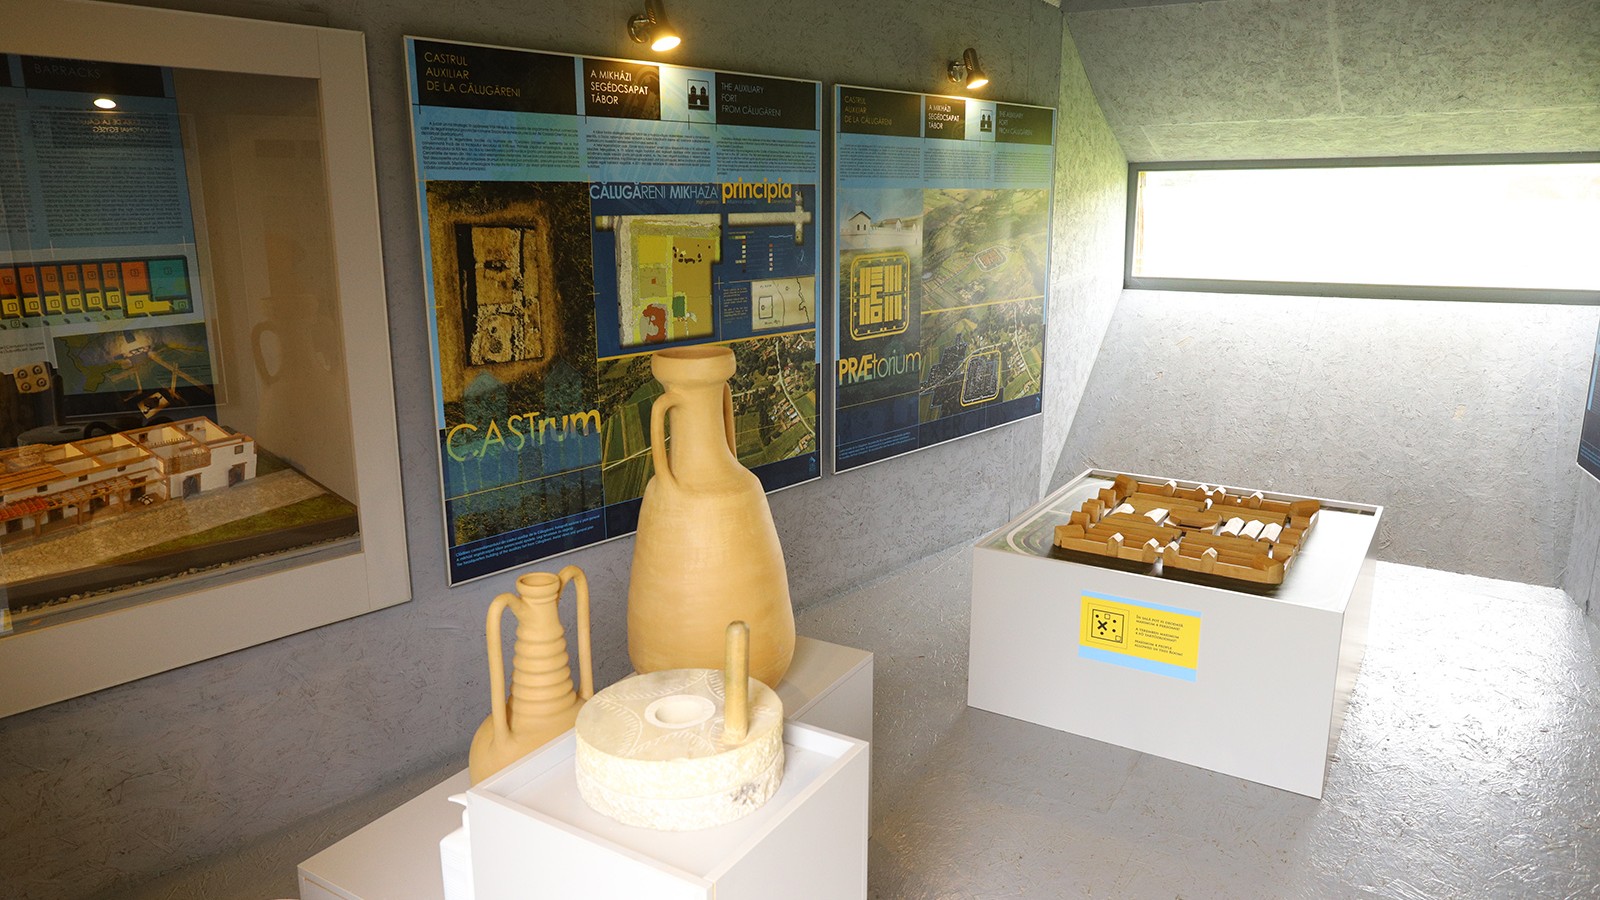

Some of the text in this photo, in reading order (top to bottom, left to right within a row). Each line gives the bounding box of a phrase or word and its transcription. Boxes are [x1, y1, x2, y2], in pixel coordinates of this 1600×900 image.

[424, 52, 468, 66] CASTRUL
[34, 63, 100, 79] BARRACKS
[426, 68, 470, 80] AUXILIAR
[590, 70, 632, 81] A MIKHÁZI
[426, 81, 521, 97] DE LA CĂLUGĂRENI
[590, 80, 648, 95] SEGÉDCSAPAT
[721, 82, 765, 94] THE AUXILIARY
[591, 93, 619, 105] TÁBOR
[722, 94, 737, 102] FORT
[722, 105, 781, 116] FROM CĂLUGĂRENI
[845, 115, 852, 123] DE
[928, 121, 944, 130] TÁBOR
[590, 180, 666, 199] CĂLUGĂRENI
[670, 184, 719, 200] MIKHAZA
[722, 177, 792, 204] principia
[446, 409, 601, 462] CASTrum
